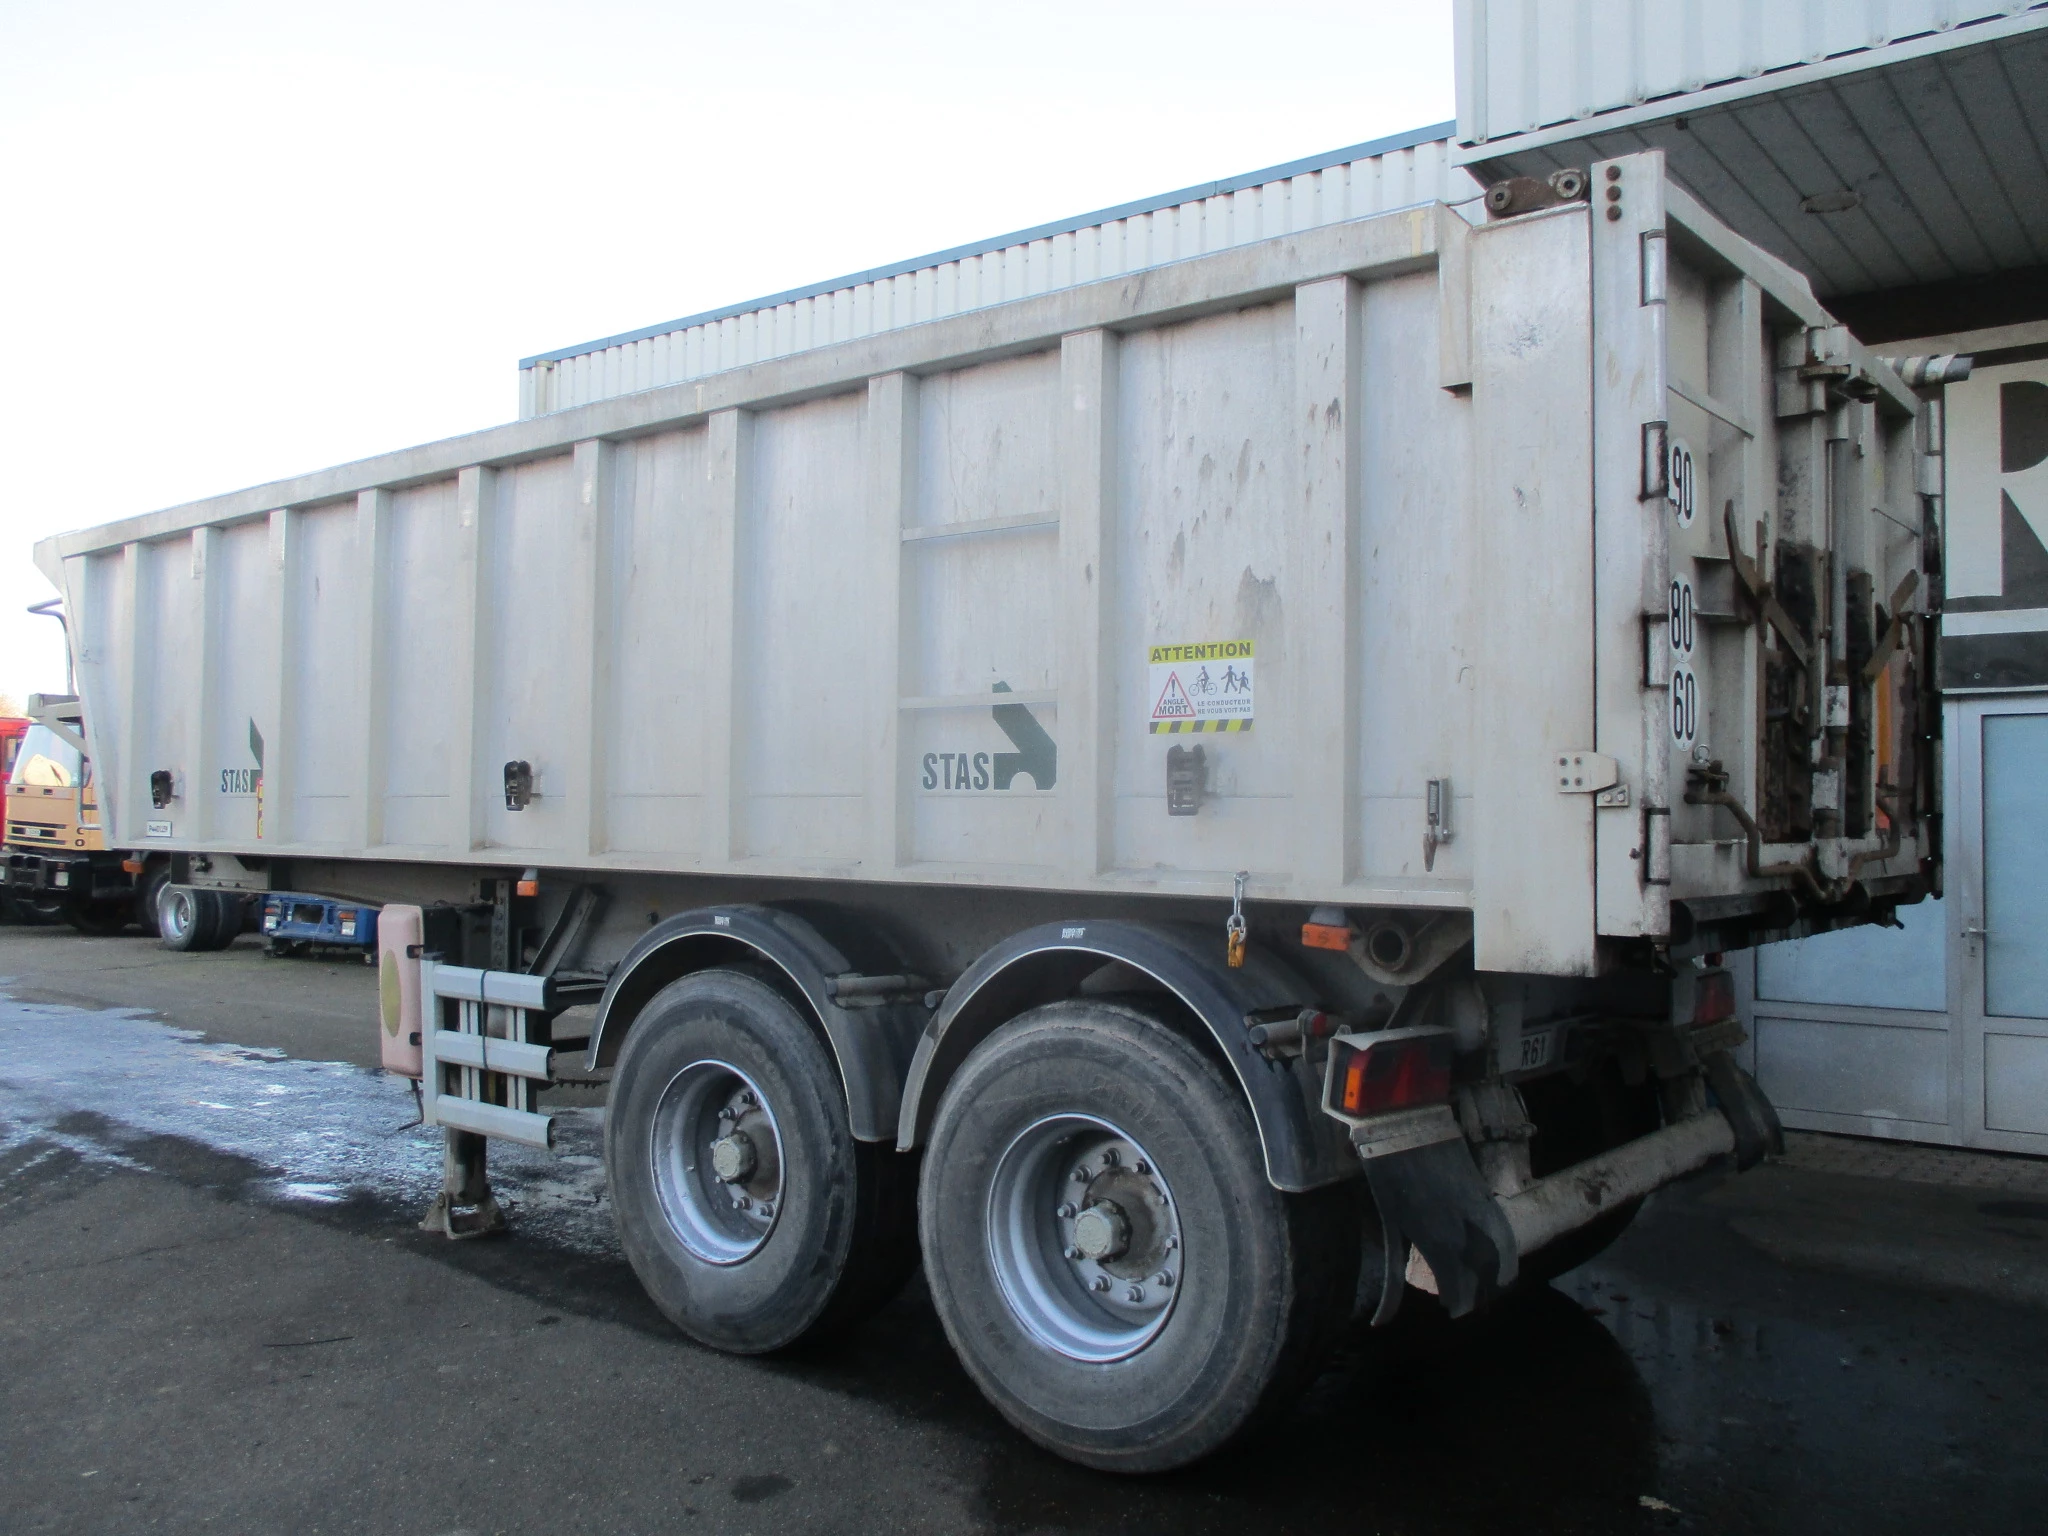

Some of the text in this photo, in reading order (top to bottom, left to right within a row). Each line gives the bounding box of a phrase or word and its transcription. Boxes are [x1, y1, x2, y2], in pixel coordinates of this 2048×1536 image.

[1672, 446, 1692, 520] 90
[1671, 580, 1692, 653] 80
[1151, 642, 1251, 662] ATTENTION
[1159, 704, 1189, 715] MORT
[1163, 698, 1185, 706] ANGLE
[1673, 670, 1695, 741] 60
[221, 768, 249, 793] STAS
[923, 752, 989, 790] STAS
[1521, 1035, 1545, 1067] R61
